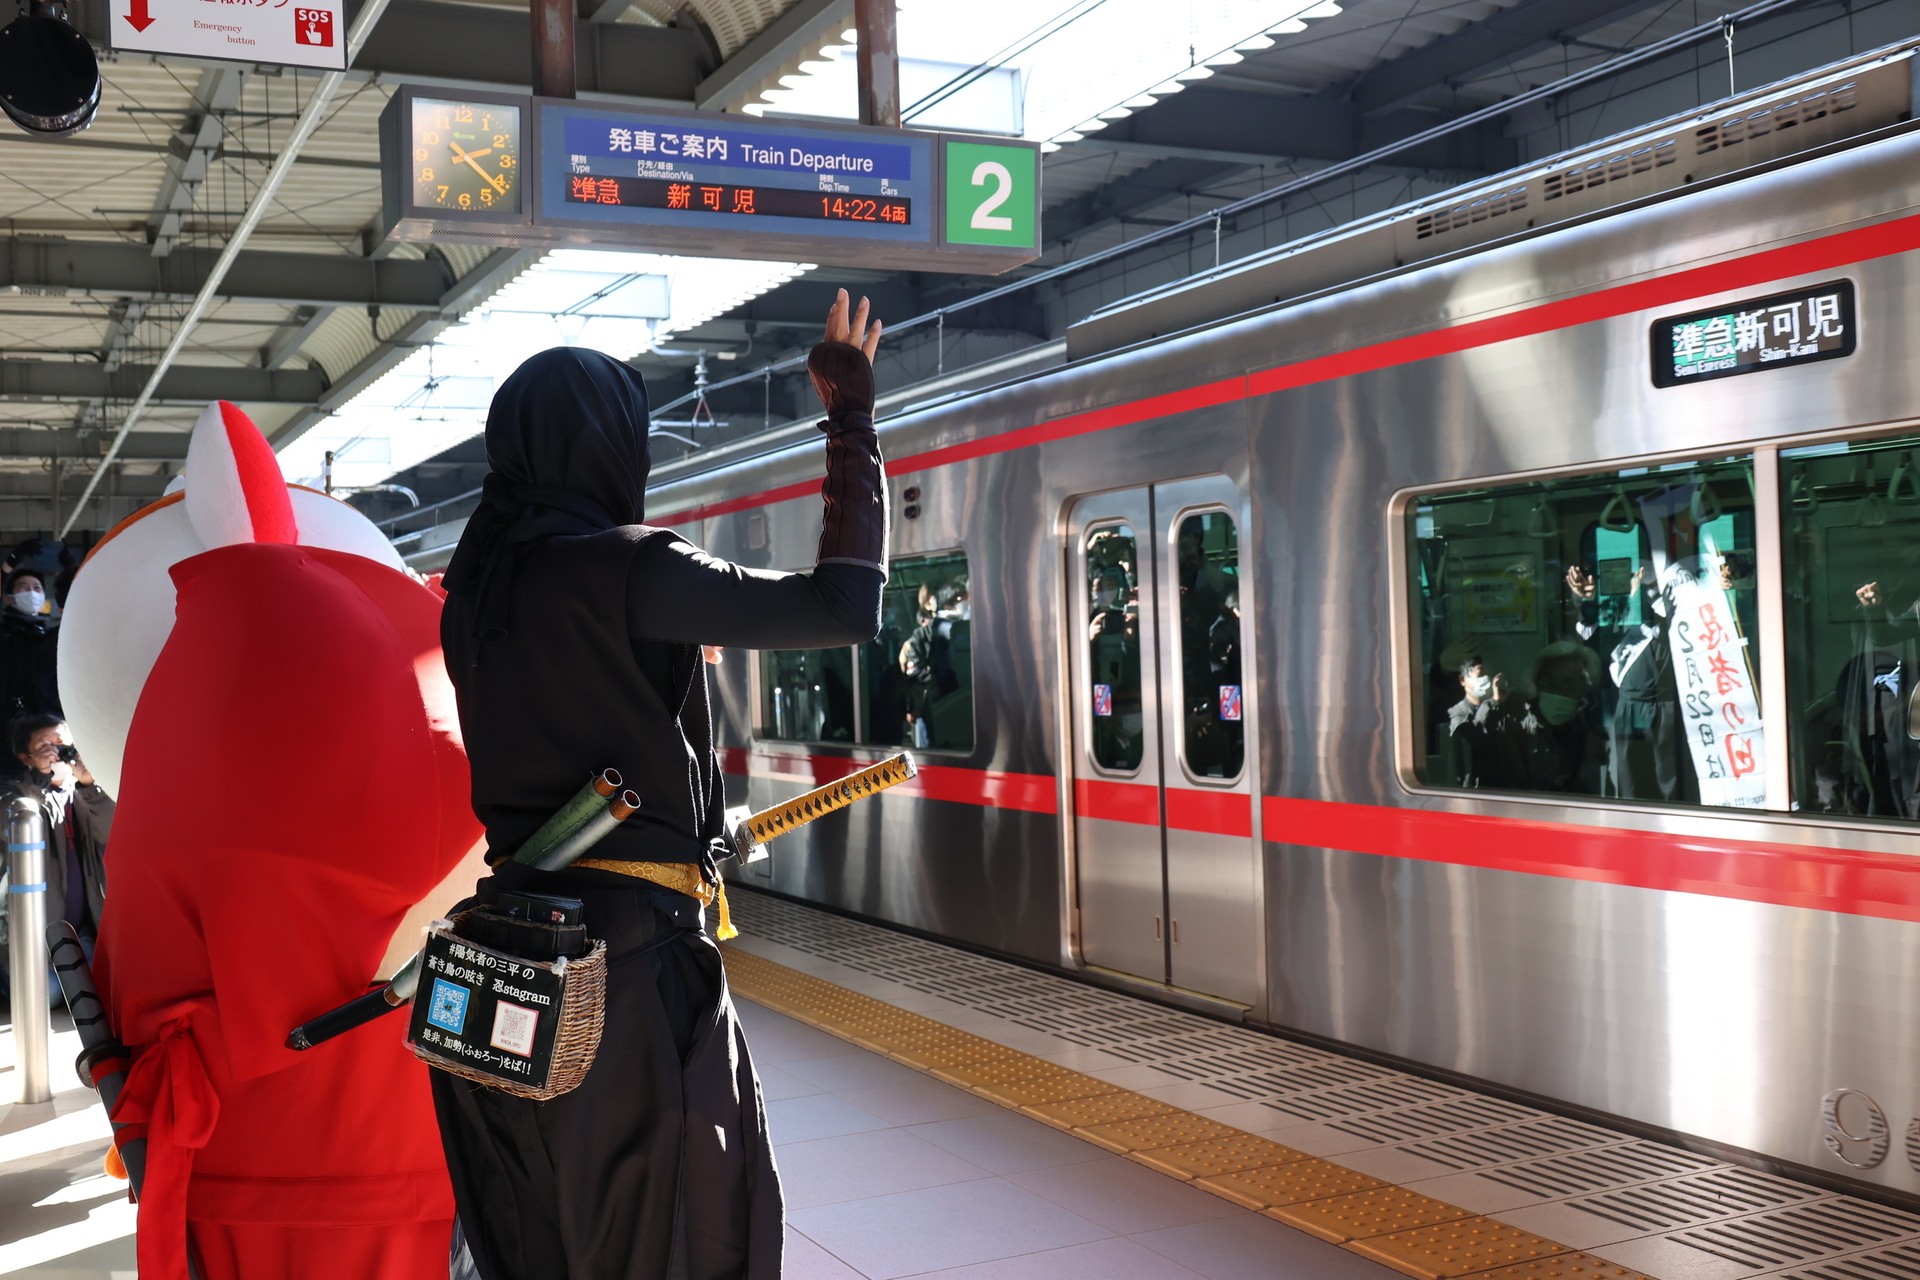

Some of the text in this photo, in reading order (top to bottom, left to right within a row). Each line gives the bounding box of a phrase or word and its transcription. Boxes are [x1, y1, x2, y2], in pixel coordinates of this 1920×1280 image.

[298, 10, 329, 23] SOS
[193, 20, 242, 33] Emergency
[227, 35, 256, 46] button
[434, 115, 451, 130] 11
[454, 109, 473, 123] 12
[481, 117, 490, 131] 1
[422, 131, 440, 145] 10
[493, 134, 505, 148] 2
[415, 148, 429, 162] 9
[609, 127, 874, 172] 発車ご案内 Train Departure
[499, 154, 512, 168] 3
[571, 154, 587, 164] 種別
[637, 159, 674, 171] 行先/経由
[421, 167, 434, 181] 8
[571, 163, 898, 196] Type Destination/Via Dep.Time Cars
[437, 185, 449, 199] 7
[480, 188, 492, 202] 5
[970, 161, 1013, 231] 2
[458, 193, 471, 207] 6
[572, 176, 622, 205] 準急
[822, 197, 876, 221] 14:22
[880, 204, 906, 224] 4両
[1672, 293, 1844, 362] 準急 新可児
[522, 967, 535, 980] の
[492, 978, 551, 1006] 忍stagram
